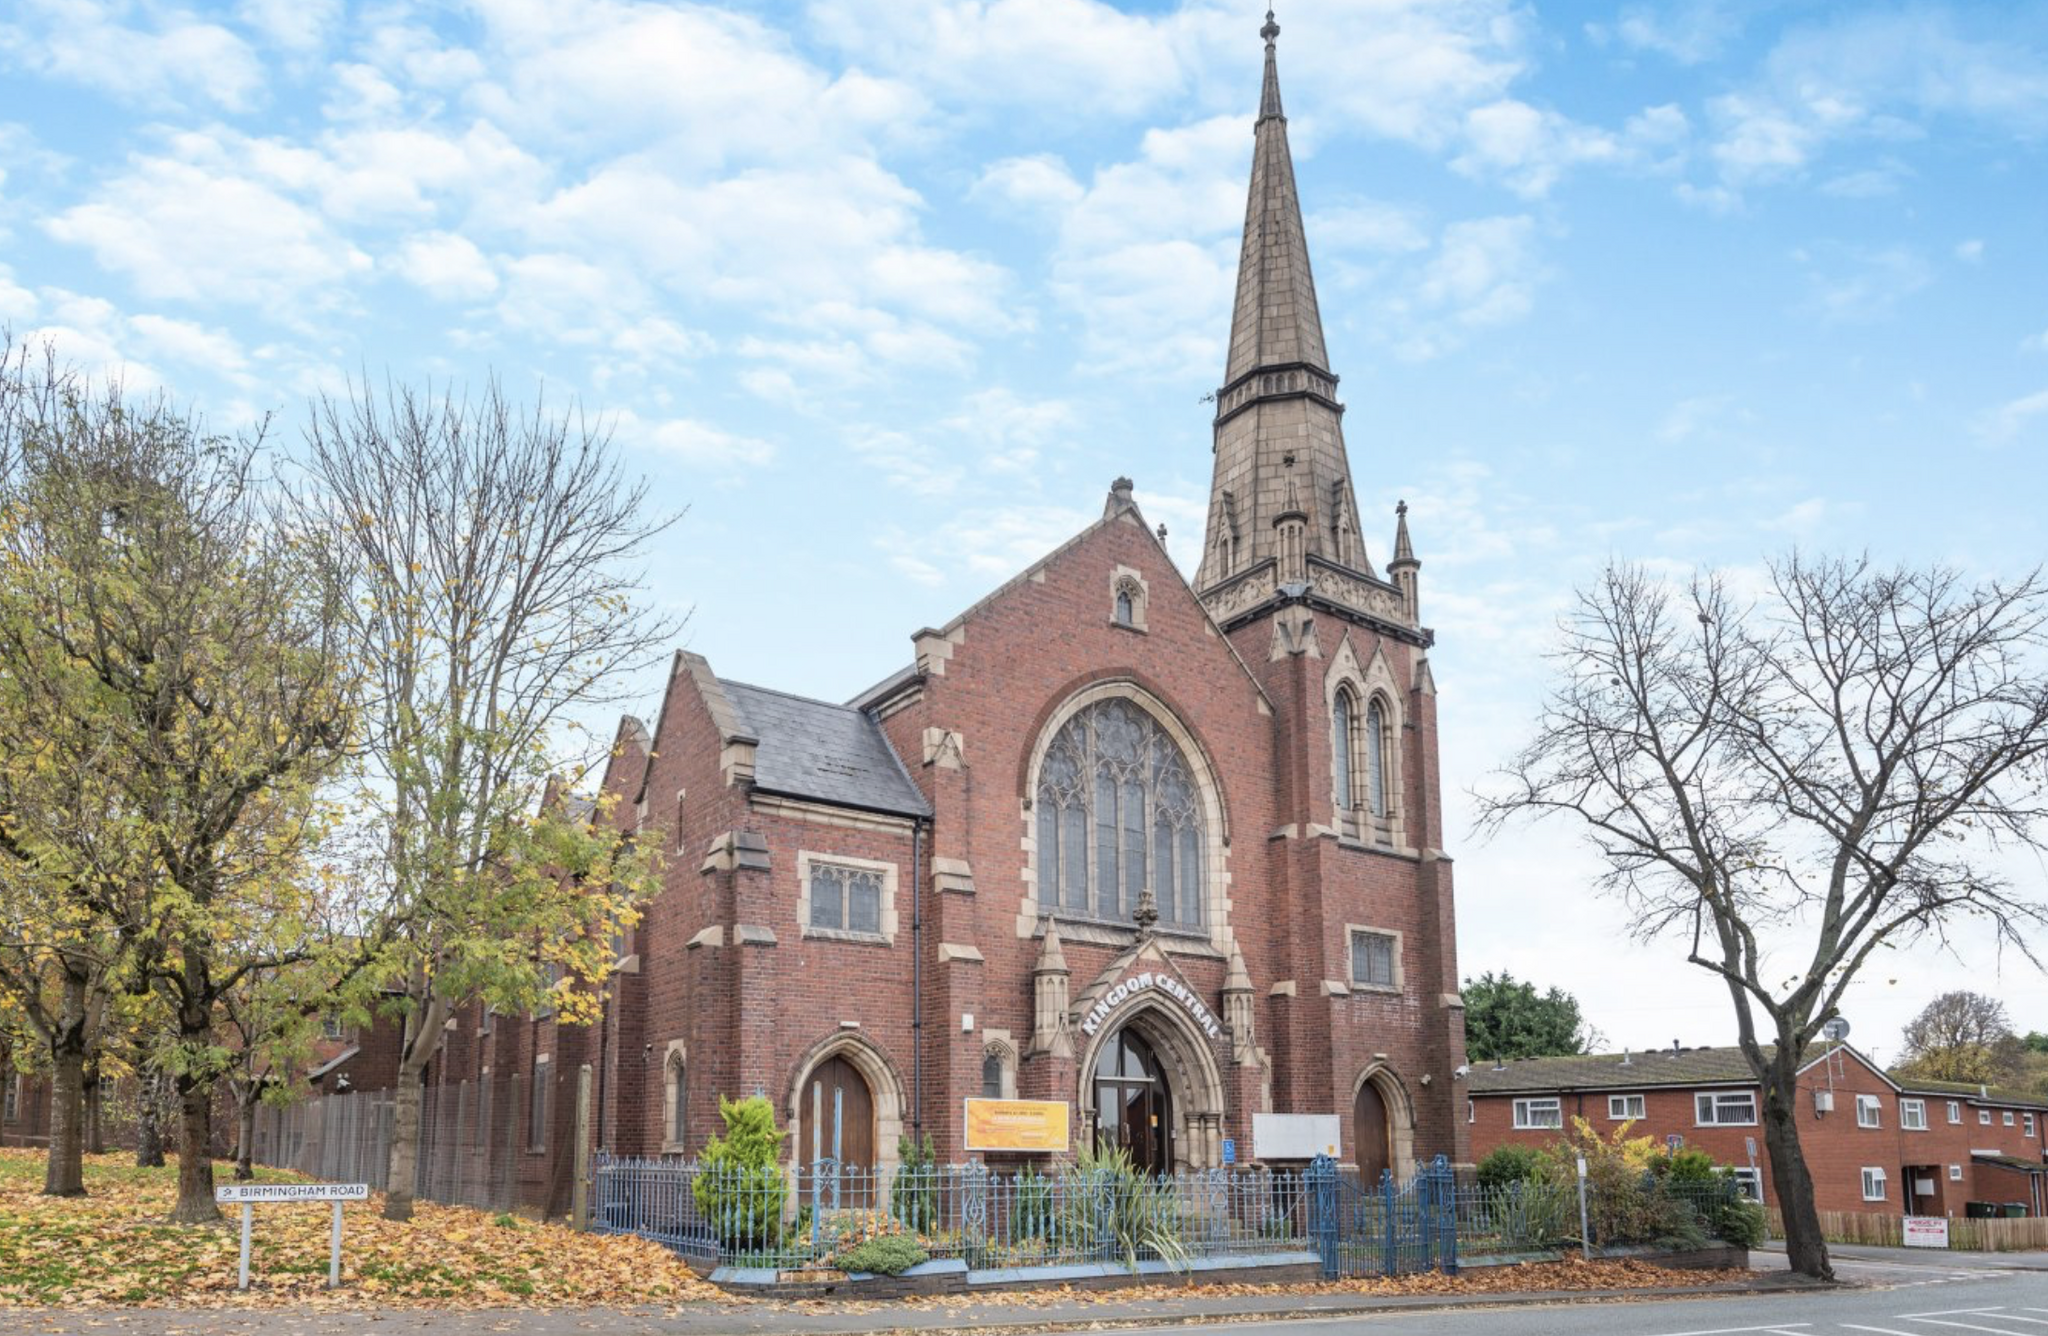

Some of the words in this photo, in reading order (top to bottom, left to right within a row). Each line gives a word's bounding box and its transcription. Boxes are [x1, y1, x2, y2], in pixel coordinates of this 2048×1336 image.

[1082, 972, 1154, 1036] KINGDOM
[1155, 972, 1219, 1039] CENTRAL
[239, 1186, 326, 1197] BIRMINGHAM
[330, 1185, 365, 1196] ROAD
